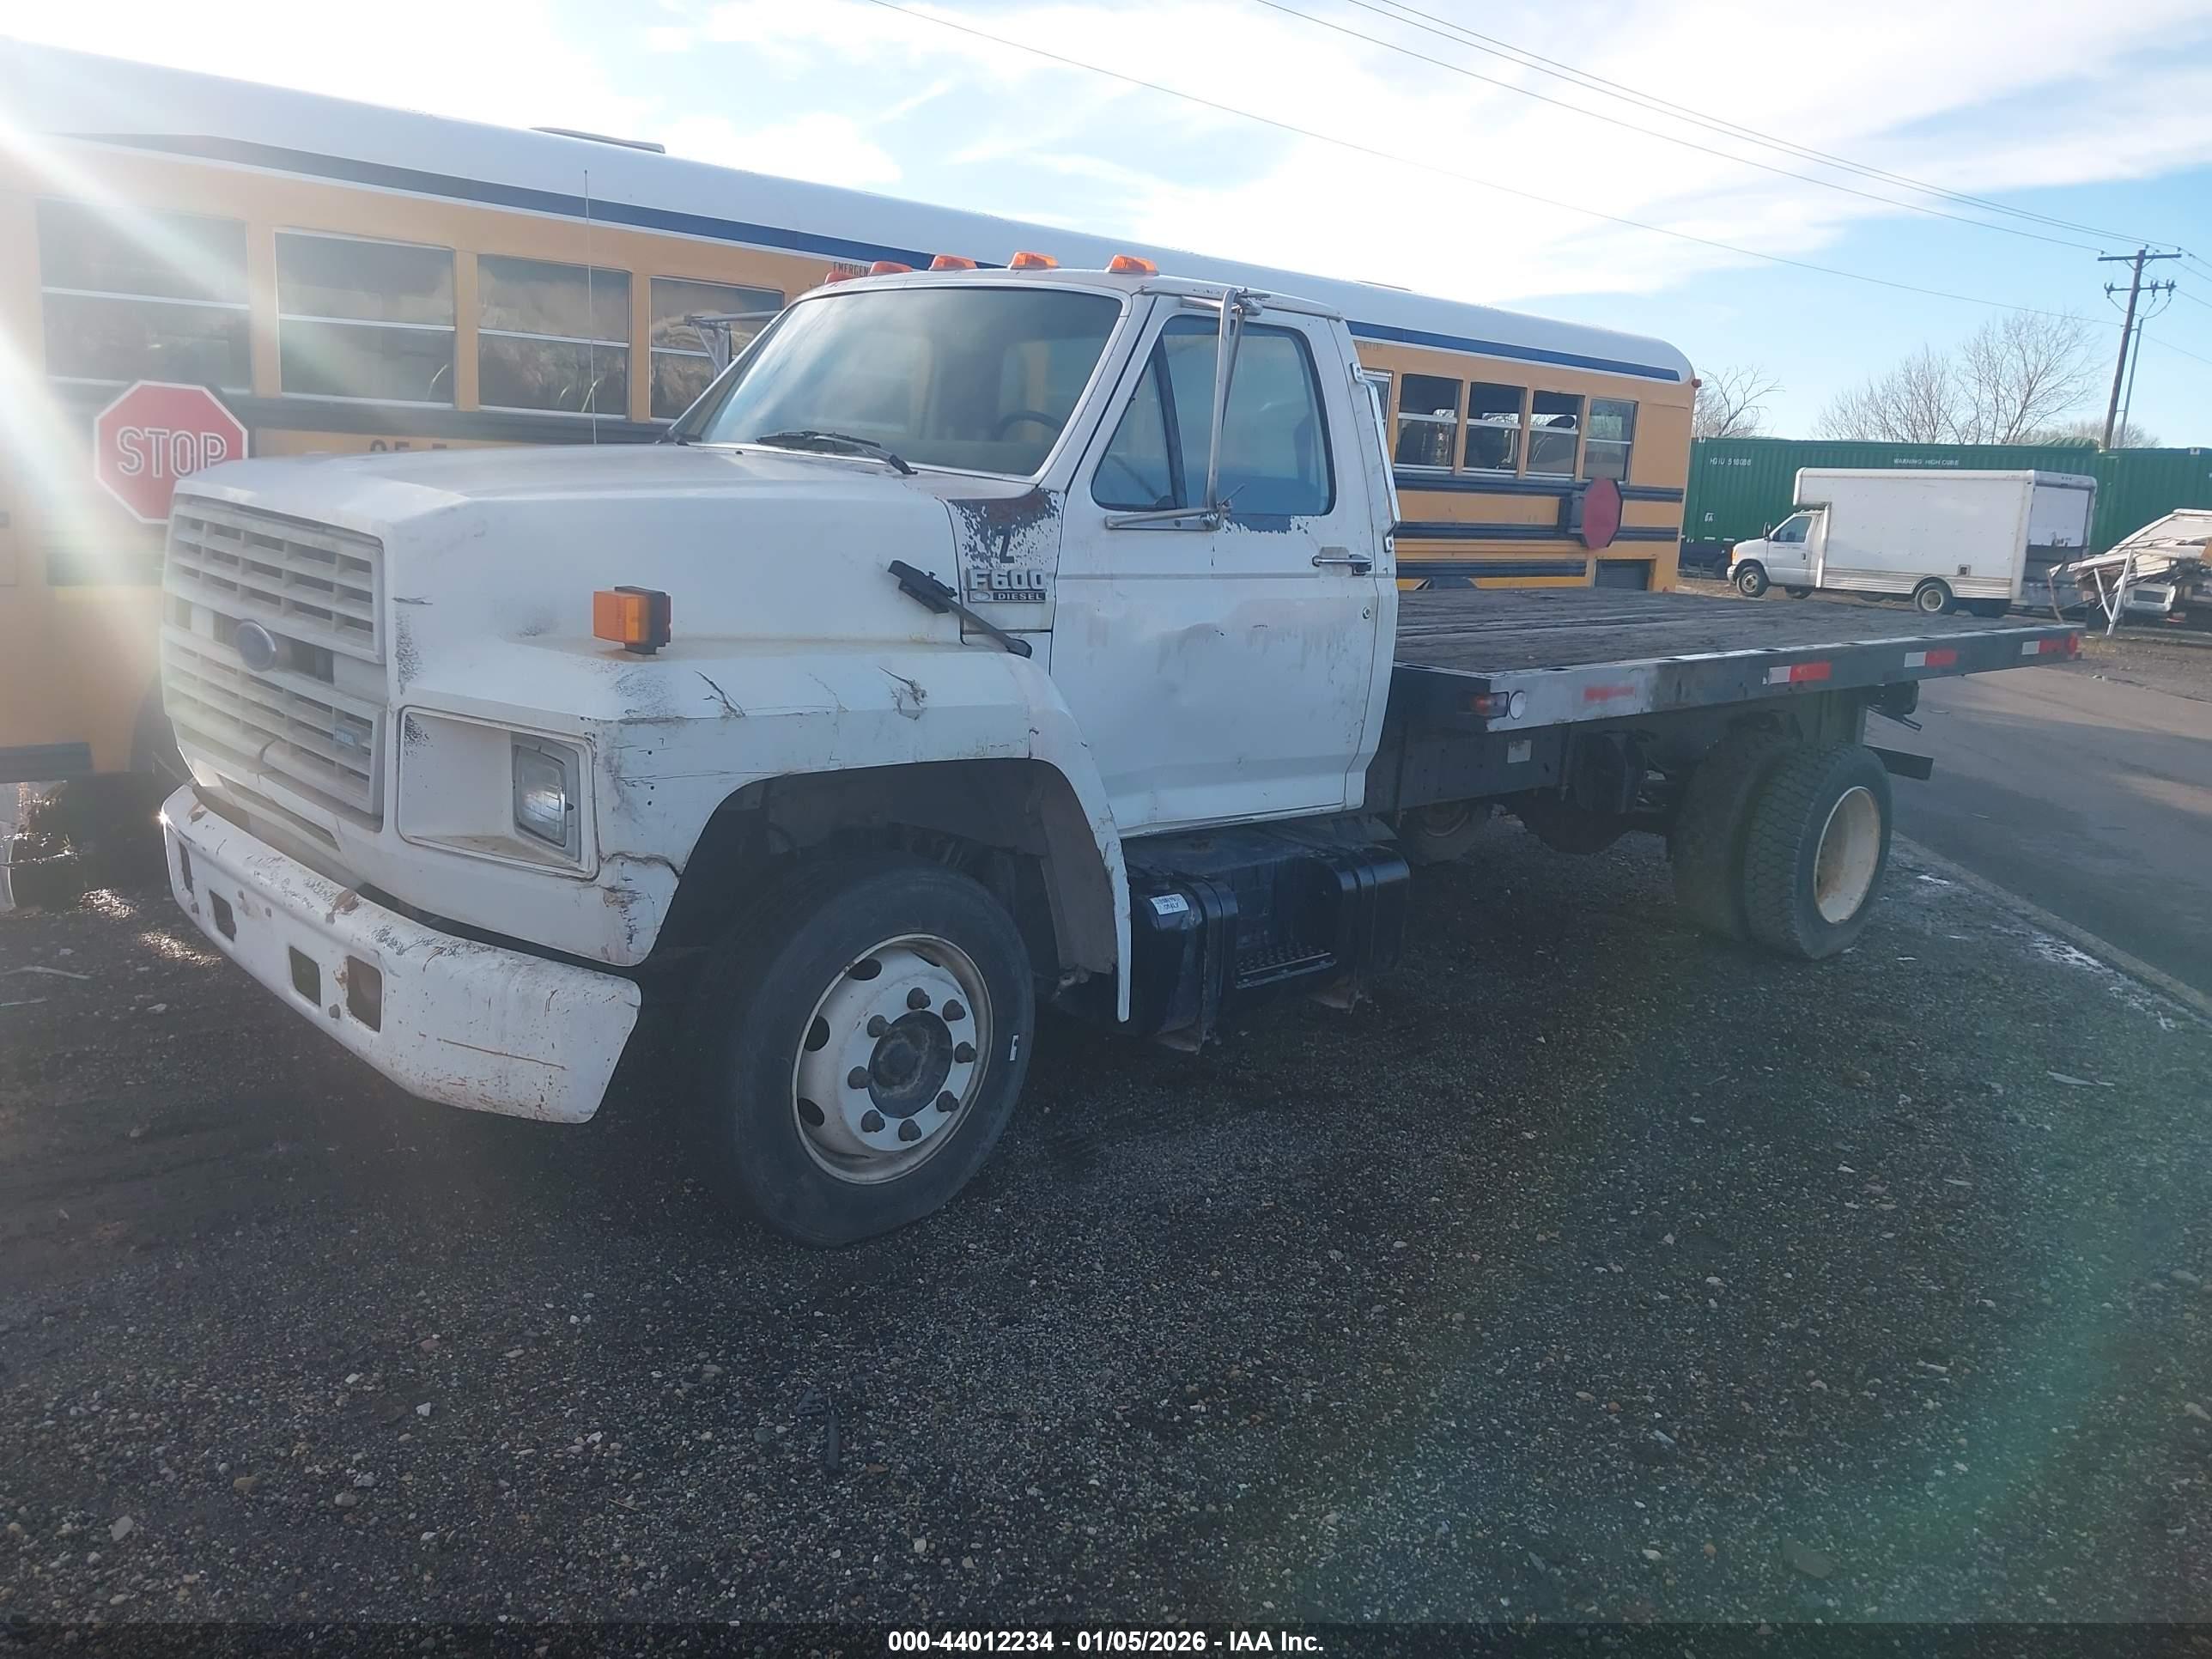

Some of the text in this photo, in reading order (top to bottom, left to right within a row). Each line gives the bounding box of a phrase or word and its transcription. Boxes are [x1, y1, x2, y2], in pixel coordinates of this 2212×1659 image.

[117, 426, 228, 478] STOP
[967, 568, 1046, 591] F600
[997, 592, 1043, 601] DIESEL
